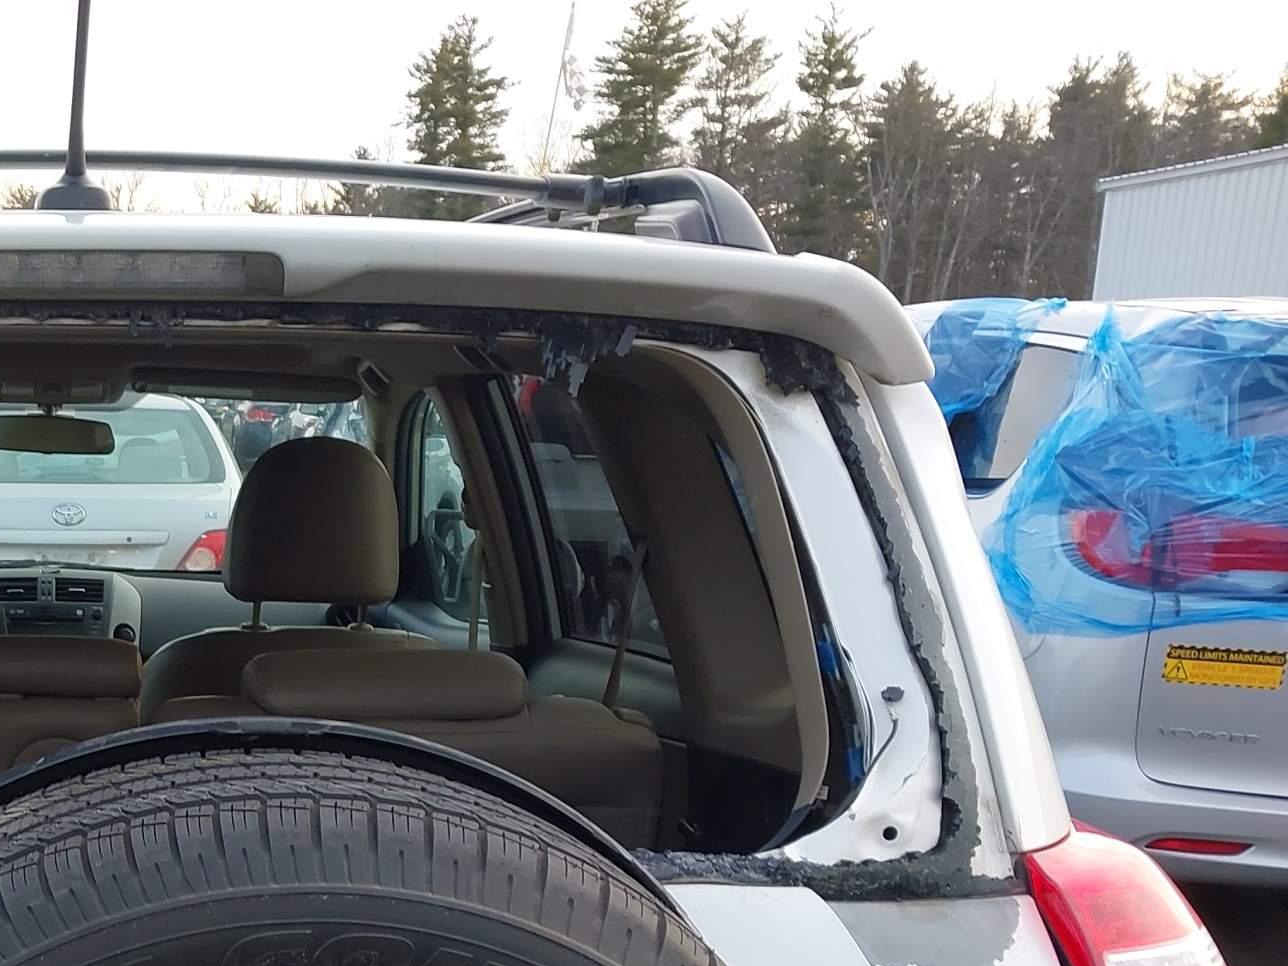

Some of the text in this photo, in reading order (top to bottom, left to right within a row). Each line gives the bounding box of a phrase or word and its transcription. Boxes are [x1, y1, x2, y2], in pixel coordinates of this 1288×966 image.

[1169, 648, 1285, 665] SPEED LIMITS MAINTAINED
